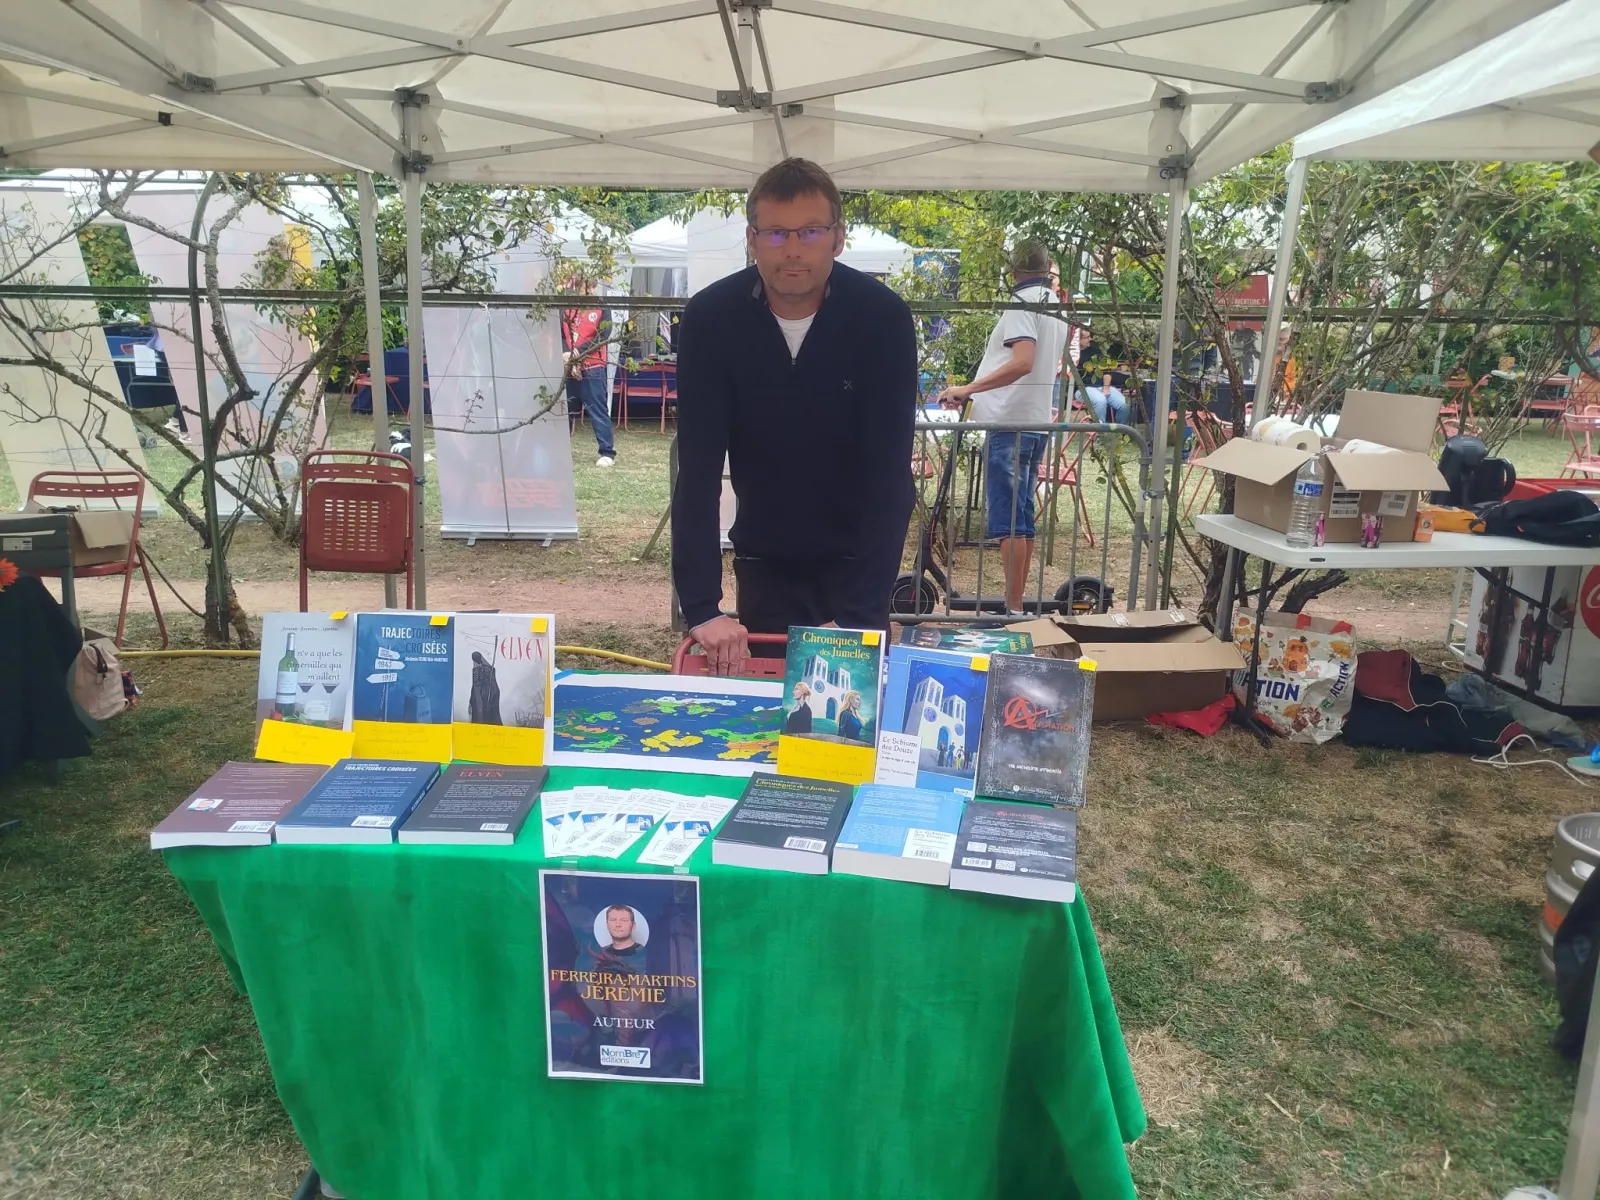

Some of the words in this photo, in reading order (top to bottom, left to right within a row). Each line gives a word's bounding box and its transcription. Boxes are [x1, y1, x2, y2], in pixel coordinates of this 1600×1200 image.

[381, 626, 441, 640] TRAJECTOIRES
[802, 631, 858, 648] Chroniques
[316, 651, 331, 660] que
[332, 648, 343, 657] les
[405, 640, 447, 655] CROISÉES
[500, 636, 543, 662] ELVEN
[819, 648, 831, 656] des
[831, 647, 871, 660] Jumelles
[328, 661, 342, 671] qui
[1241, 672, 1300, 702] ATION
[1329, 661, 1349, 698] ACTION
[551, 969, 697, 988] FERREIRA-MARTINS
[580, 981, 666, 1004] JÉRÉMIE
[593, 1016, 656, 1030] AUTEUR
